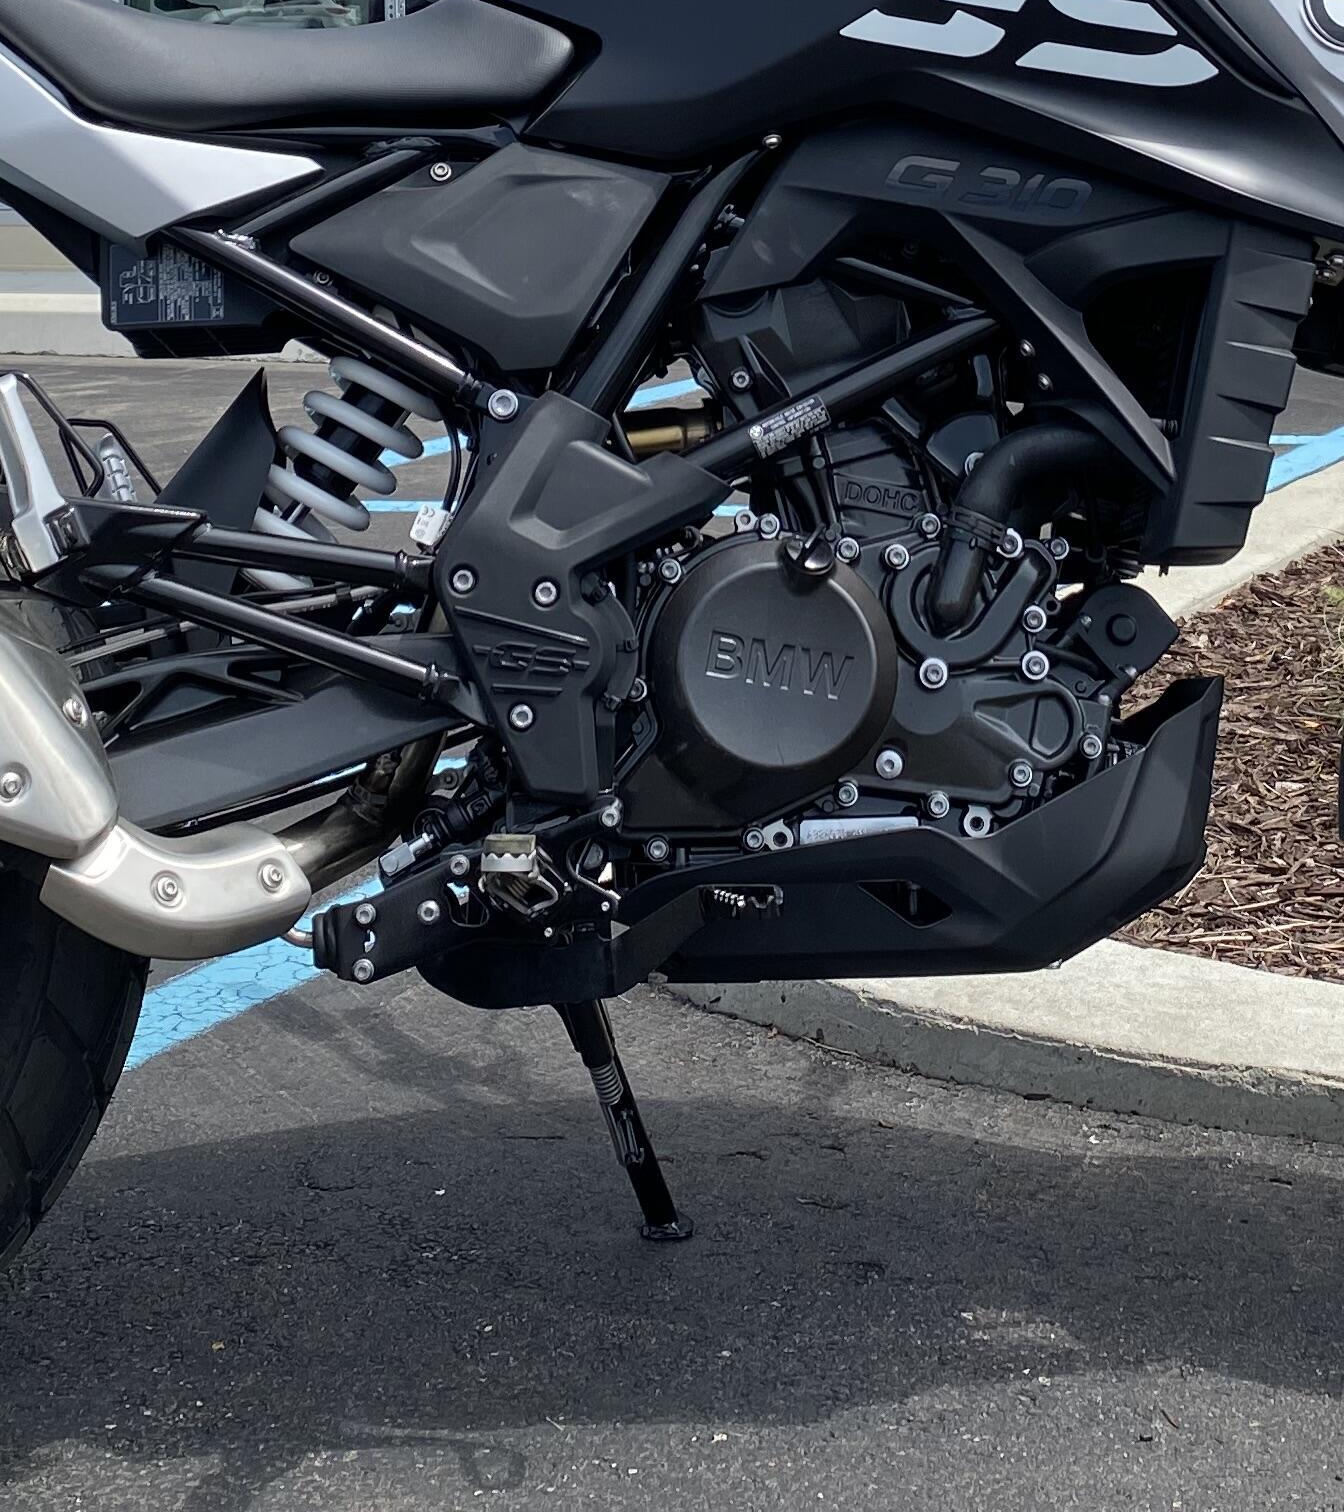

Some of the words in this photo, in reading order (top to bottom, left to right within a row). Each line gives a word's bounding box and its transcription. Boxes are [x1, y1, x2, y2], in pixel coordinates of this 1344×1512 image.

[884, 154, 960, 193] G
[844, 480, 920, 514] DOHC
[705, 628, 856, 701] BMW
